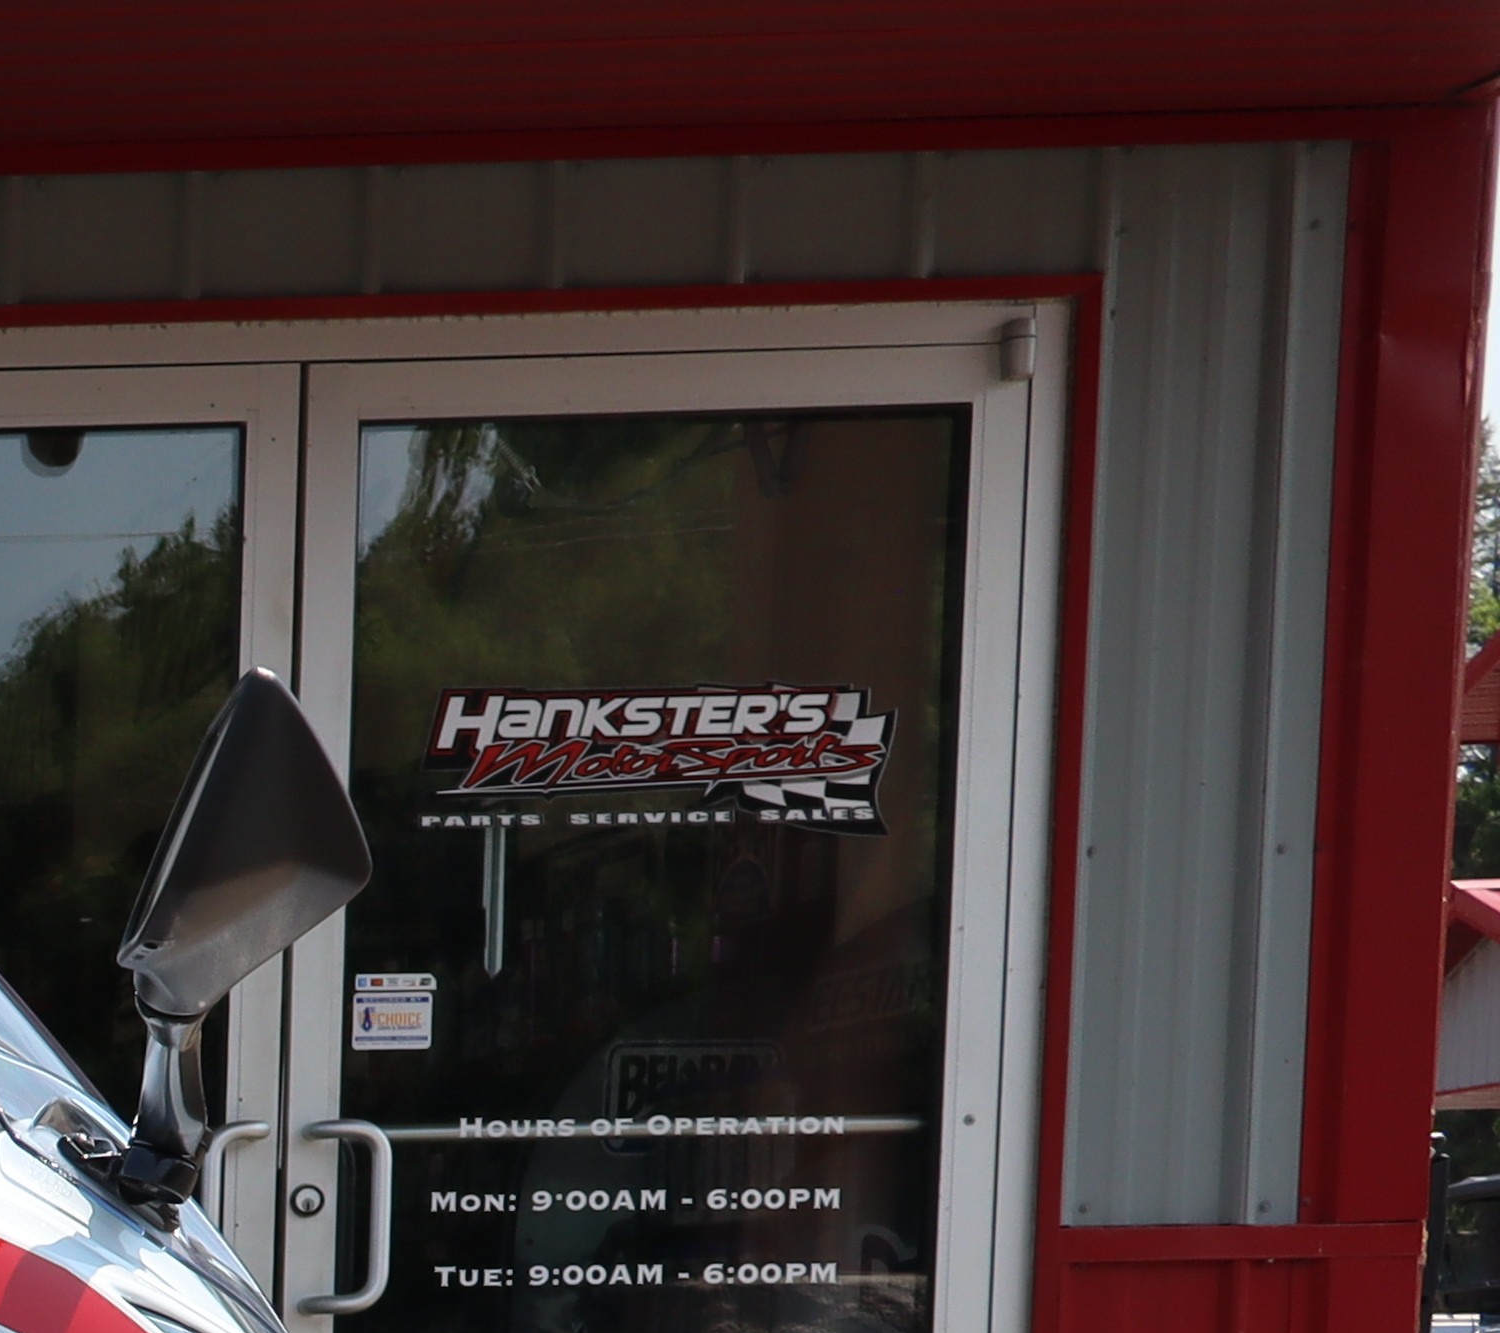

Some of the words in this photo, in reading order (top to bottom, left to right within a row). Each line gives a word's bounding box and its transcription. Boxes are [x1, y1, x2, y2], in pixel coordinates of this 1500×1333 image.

[420, 812, 542, 828] PARTS
[569, 809, 732, 826] SERVICE
[758, 806, 875, 822] SALES
[706, 1188, 841, 1210] 6:00PM
[529, 1264, 663, 1286] 9:00AM
[703, 1262, 837, 1285] 6:00PM
